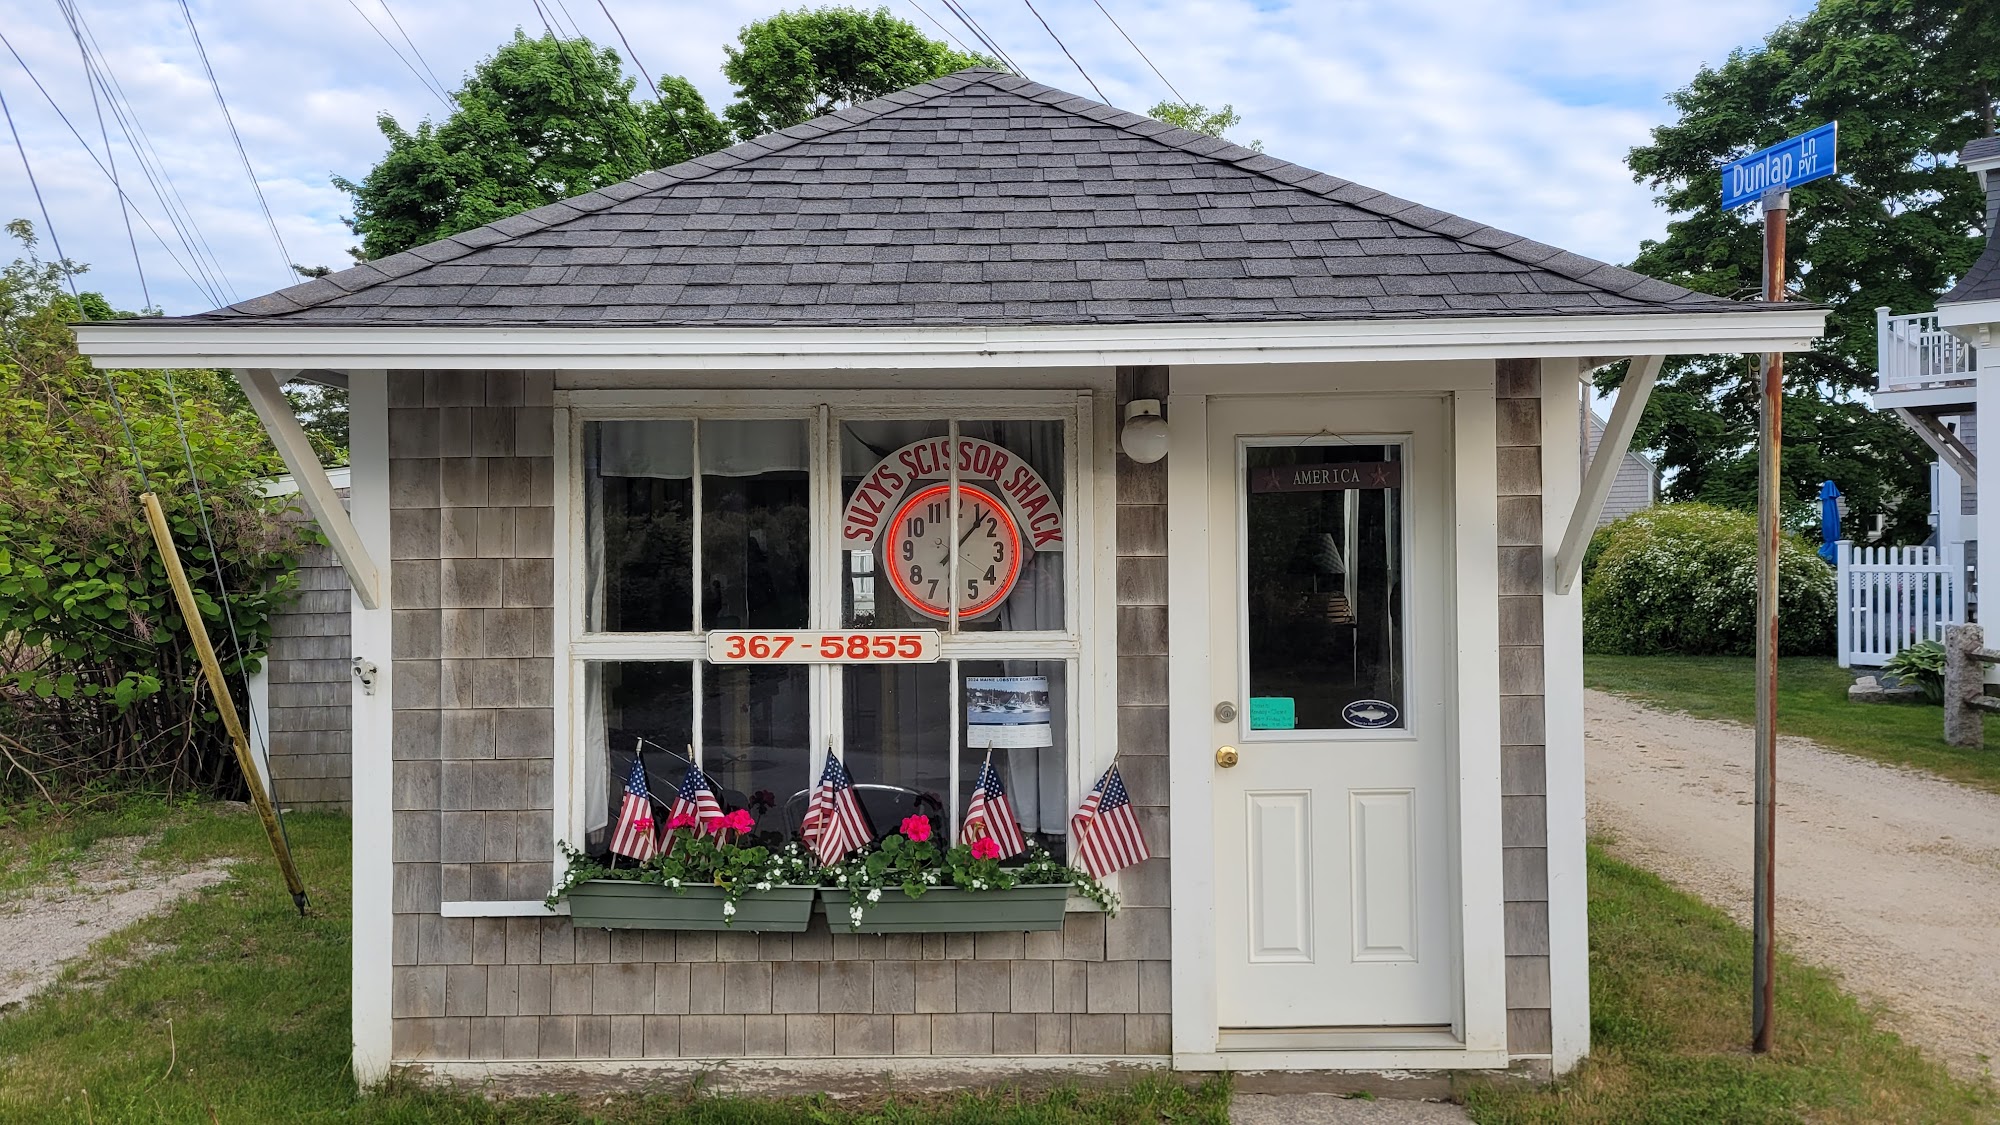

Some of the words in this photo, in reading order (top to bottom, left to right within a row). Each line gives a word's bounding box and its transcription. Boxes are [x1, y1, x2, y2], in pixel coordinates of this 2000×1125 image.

[1733, 152, 1793, 198] Dunlap
[1800, 136, 1816, 158] Ln
[1798, 154, 1818, 178] PVT
[1293, 468, 1360, 485] AMERICA
[843, 464, 904, 541] SUZYS
[898, 440, 1009, 481] SCISSOR
[1003, 465, 1063, 548] SHACK
[927, 502, 941, 523] 11
[906, 517, 925, 537] 10
[986, 517, 997, 537] 2
[902, 540, 914, 561] 9
[993, 541, 1004, 562] 3
[909, 564, 923, 585] 8
[983, 564, 996, 585] 4
[927, 579, 939, 599] 7
[967, 579, 979, 599] 5
